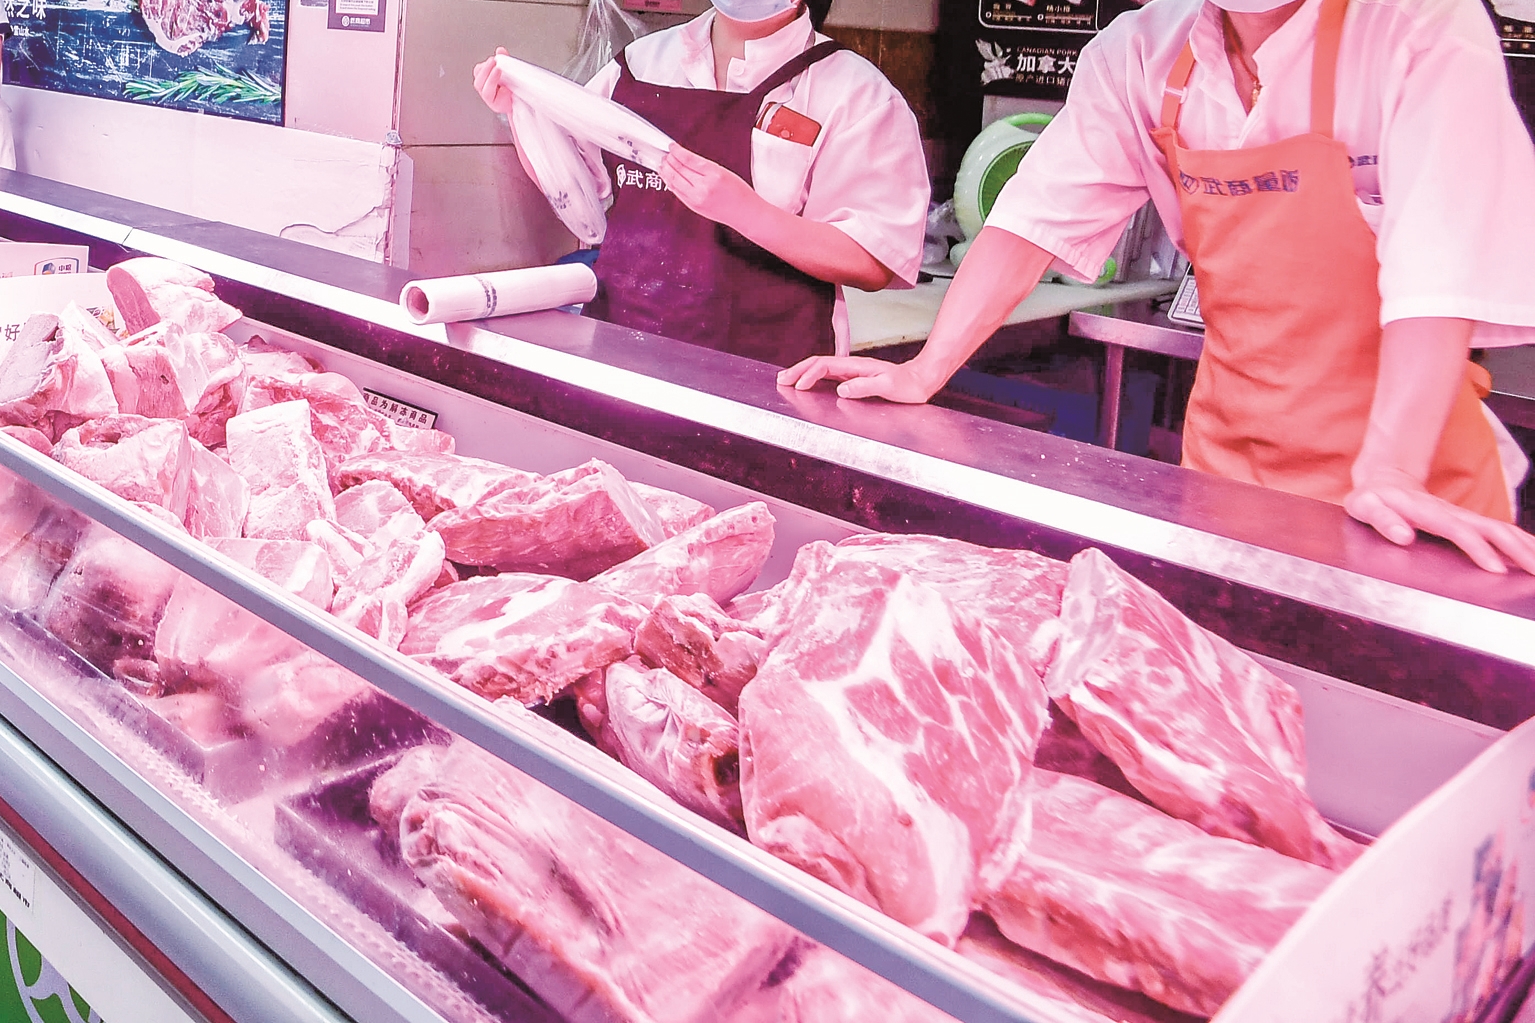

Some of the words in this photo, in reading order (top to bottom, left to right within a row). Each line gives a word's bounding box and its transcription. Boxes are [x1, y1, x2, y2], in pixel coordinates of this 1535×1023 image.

[1016, 53, 1077, 75] 加拿大
[625, 169, 671, 192] 武商
